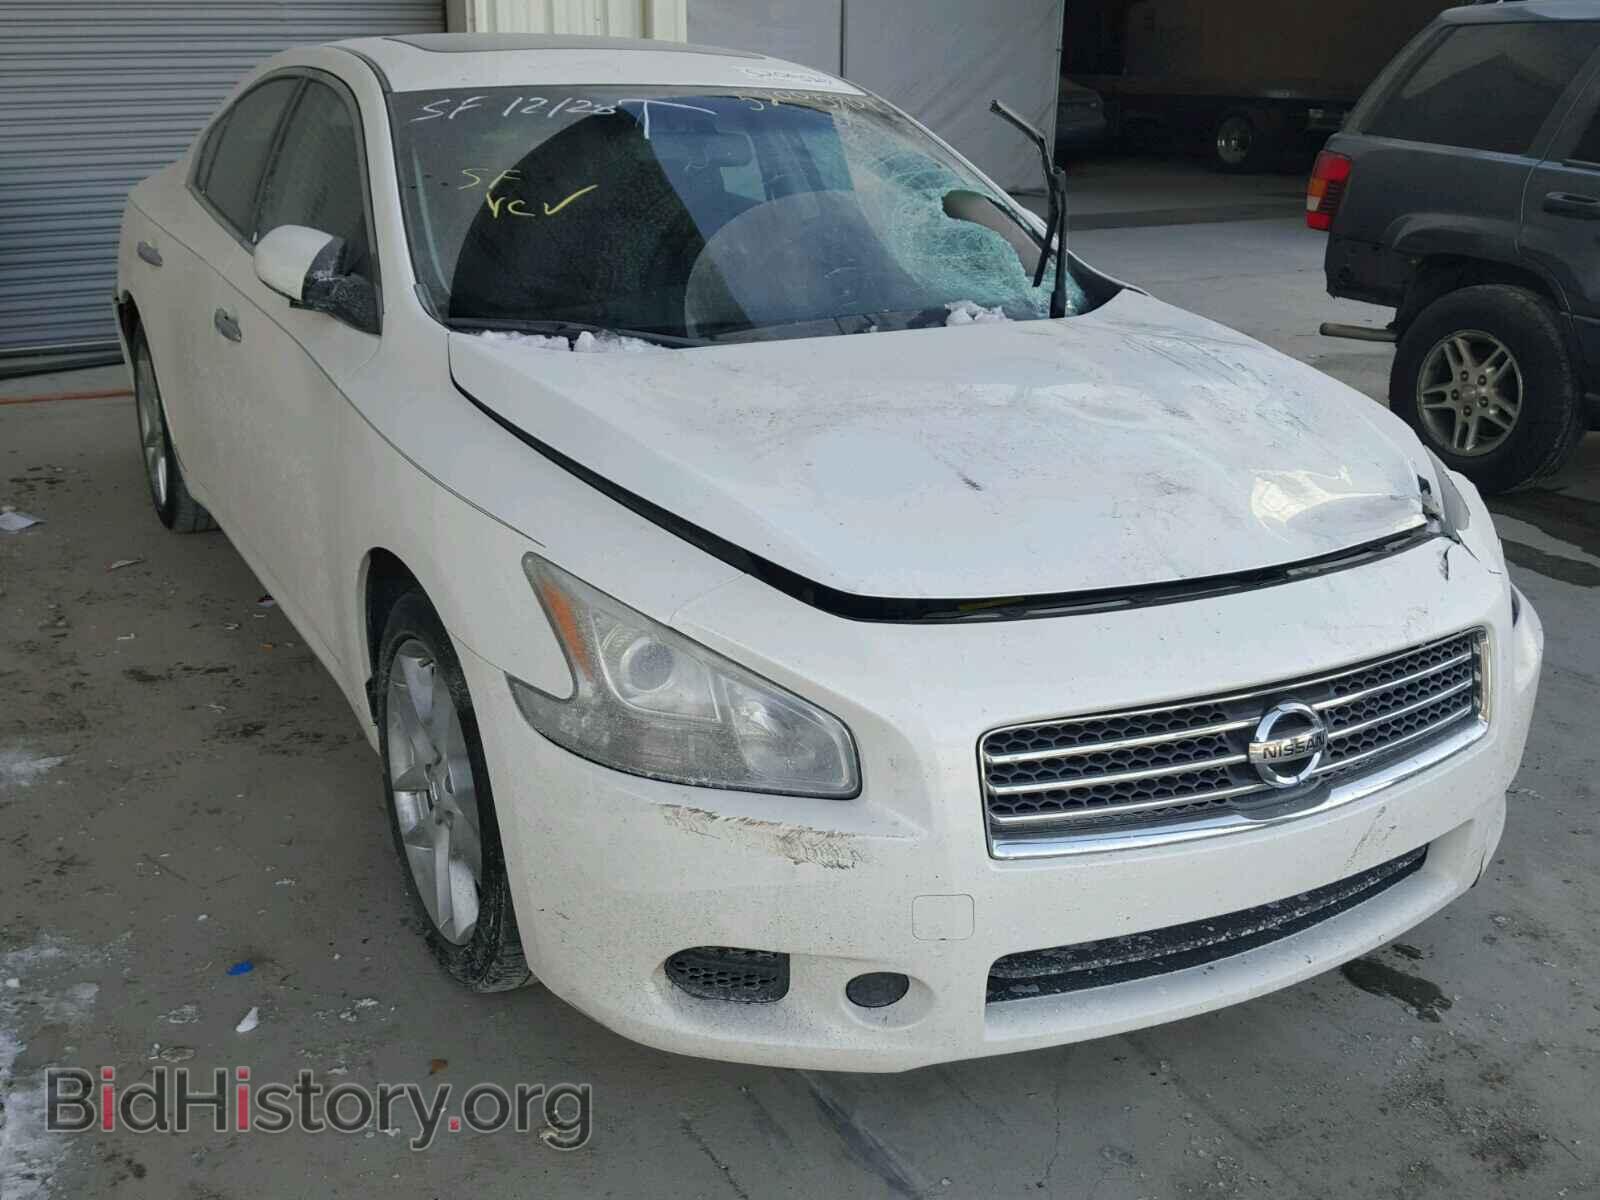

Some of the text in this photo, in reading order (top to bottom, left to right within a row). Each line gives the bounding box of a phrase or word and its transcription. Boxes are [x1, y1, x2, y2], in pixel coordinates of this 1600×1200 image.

[410, 95, 488, 122] SF
[457, 168, 521, 190] SF
[1262, 732, 1325, 760] NISSAN
